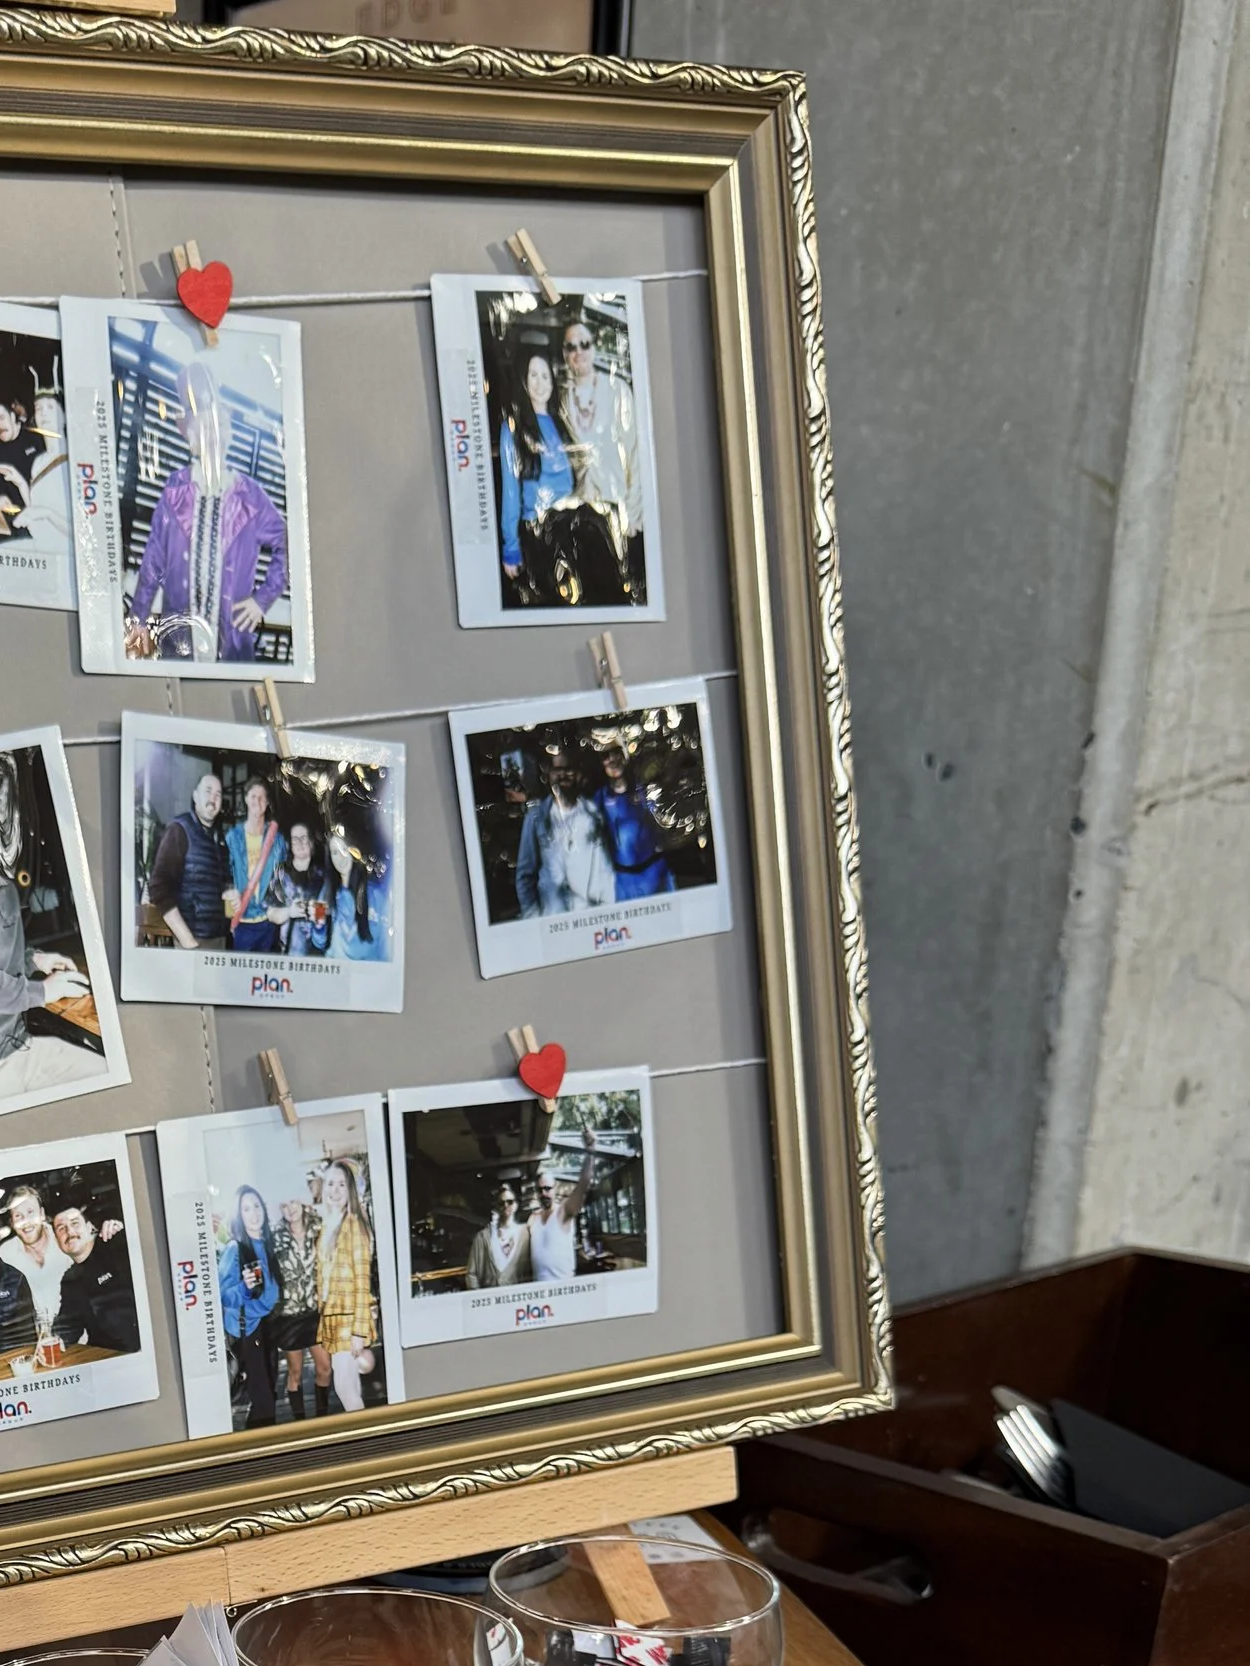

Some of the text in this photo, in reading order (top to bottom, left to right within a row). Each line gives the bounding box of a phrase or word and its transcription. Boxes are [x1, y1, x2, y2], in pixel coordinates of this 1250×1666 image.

[204, 956, 341, 974] 2025 MILESTONE BIRTHDAYS
[195, 1202, 218, 1363] 2025 MILESTONE BIRTHDAYS
[22, 1374, 82, 1393] BIRTHDAYS
